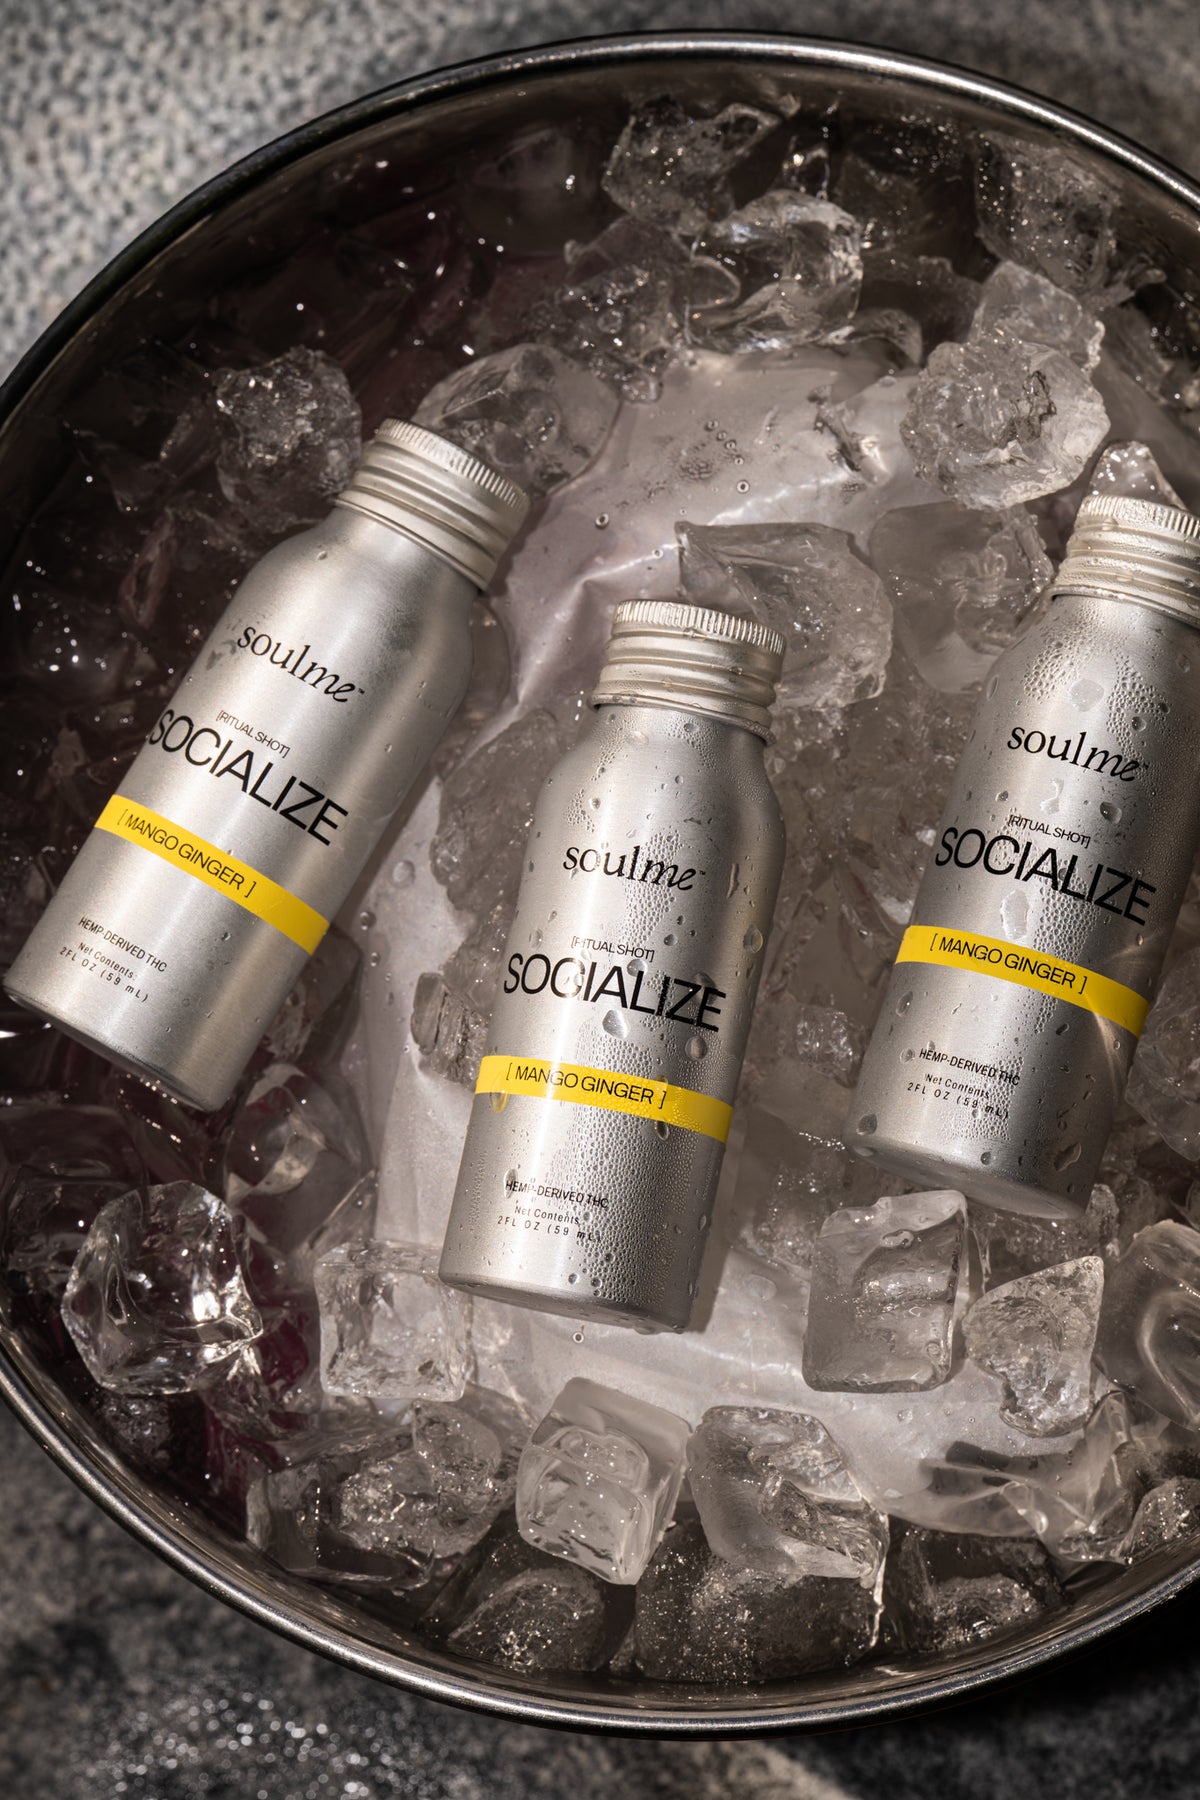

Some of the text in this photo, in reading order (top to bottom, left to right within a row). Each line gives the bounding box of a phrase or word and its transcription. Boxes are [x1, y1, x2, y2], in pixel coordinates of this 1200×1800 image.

[215, 710, 291, 759] [RITUAL SHOT]
[148, 709, 348, 846] SOCIALIZE
[125, 814, 179, 851] MANGO
[178, 843, 245, 891] GINGER
[1053, 827, 1091, 849] SHOT]
[935, 827, 1156, 926] SOCIALIZE
[78, 942, 93, 956] Net
[79, 917, 168, 972] HEMP-DERIVED THC
[616, 944, 656, 963] SHOT]
[939, 936, 1003, 963] MANGO
[1004, 953, 1076, 989] GINGER
[81, 959, 97, 972] OZ
[504, 953, 726, 1032] SOCIALIZE
[515, 1065, 579, 1088] MANGO
[581, 1076, 654, 1104] GINGER
[919, 1048, 1020, 1086] HEMP-DERIVED THC
[925, 1073, 942, 1085] Net
[934, 1088, 951, 1101] OZ
[515, 1206, 531, 1217] Net
[524, 1220, 541, 1231] OZ
